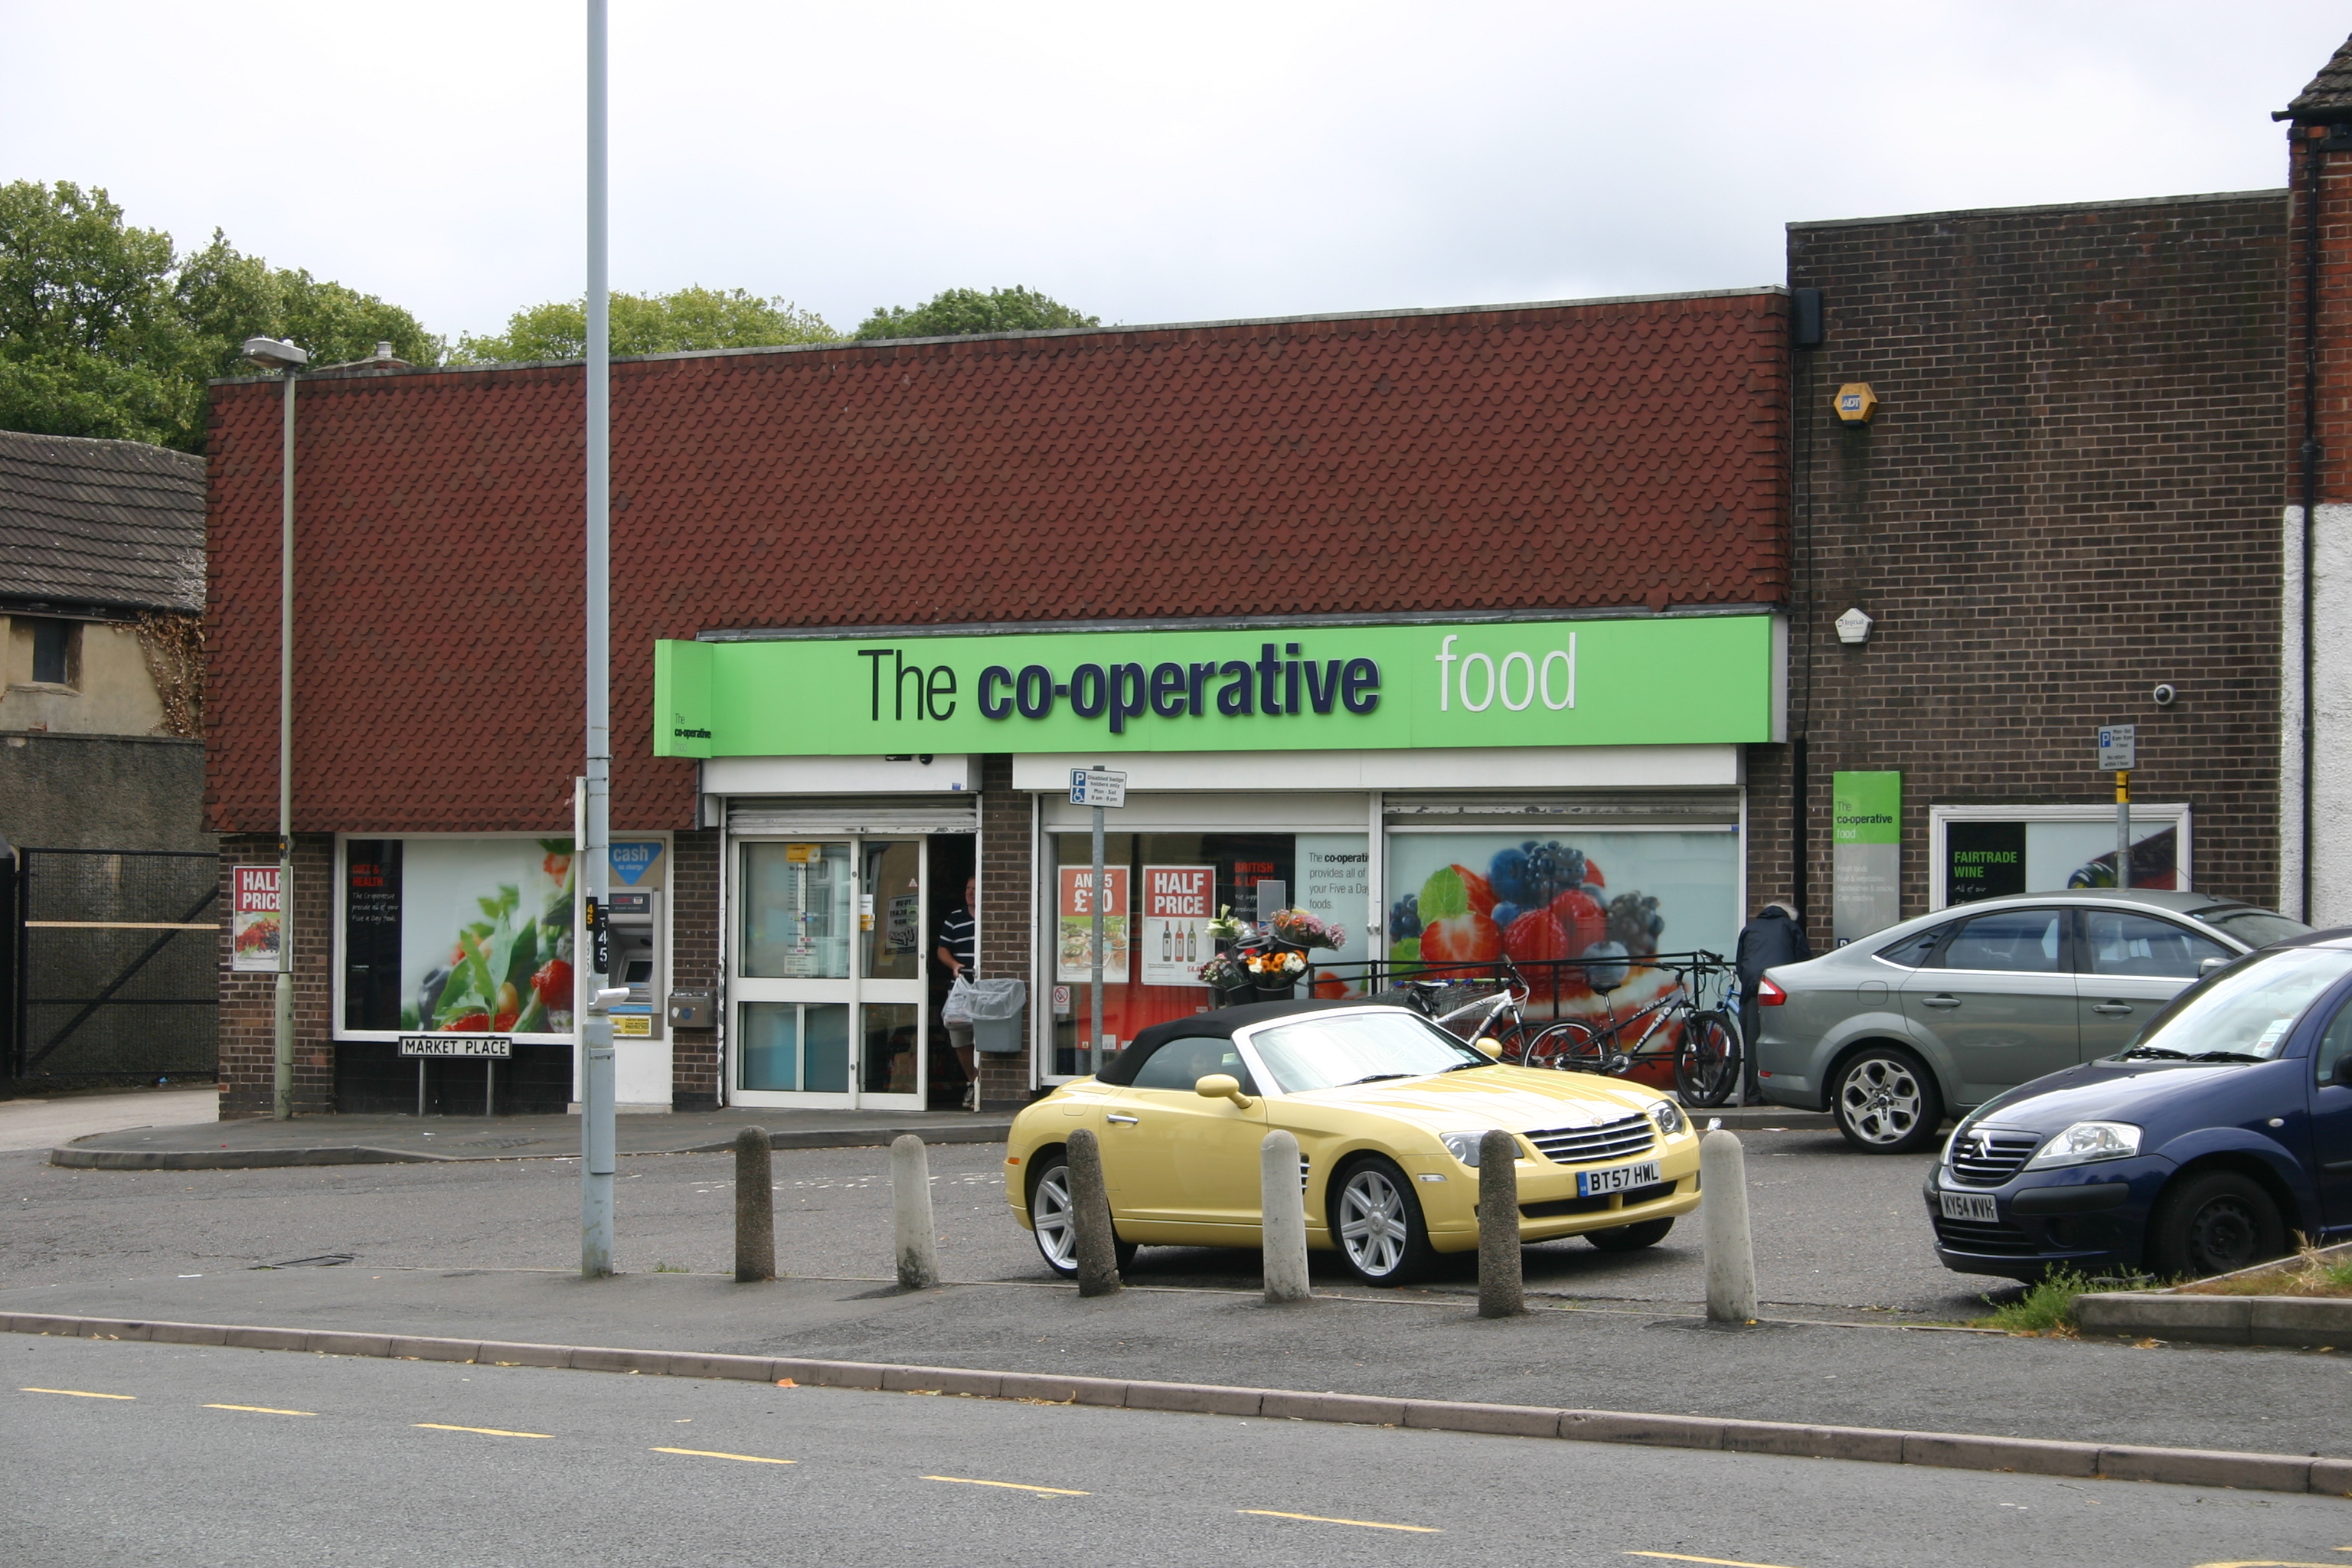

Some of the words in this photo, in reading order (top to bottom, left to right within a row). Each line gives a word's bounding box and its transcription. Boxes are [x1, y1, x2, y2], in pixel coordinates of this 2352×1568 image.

[1841, 398, 1860, 407] ADT
[858, 649, 956, 721] The
[978, 642, 1380, 733] co-operative
[1436, 632, 1577, 712] food
[675, 713, 684, 724] The
[675, 728, 711, 740] co-operative
[1838, 802, 1851, 812] The
[1838, 814, 1893, 825] co-operative
[1838, 828, 1856, 838] food
[613, 845, 648, 861] cash
[1309, 853, 1323, 862] The
[1325, 853, 1369, 864] co-operati
[1955, 851, 2017, 863] FAIRTRADE
[1234, 862, 1274, 873] BRITISH
[1954, 867, 1984, 877] WINE
[1309, 868, 1344, 880] provides
[1346, 868, 1355, 877] all
[1358, 868, 1366, 877] of
[352, 877, 384, 887] HEALTH
[1074, 874, 1093, 887] AN
[1104, 874, 1112, 887] 5
[1155, 873, 1204, 893] HALF
[1234, 875, 1242, 887] &
[1309, 885, 1327, 895] your
[1330, 884, 1345, 893] Five
[1348, 885, 1353, 893] a
[1955, 884, 1965, 892] All
[1074, 889, 1112, 913] £0
[1155, 896, 1204, 914] PRICE
[1309, 899, 1334, 909] foods.
[406, 1040, 458, 1054] MARKET
[466, 1041, 506, 1054] PLACE
[1590, 1168, 1630, 1191] BT57
[1634, 1164, 1658, 1184] HWL
[1944, 1196, 1969, 1217] KY54
[1971, 1197, 1994, 1218] WVH
